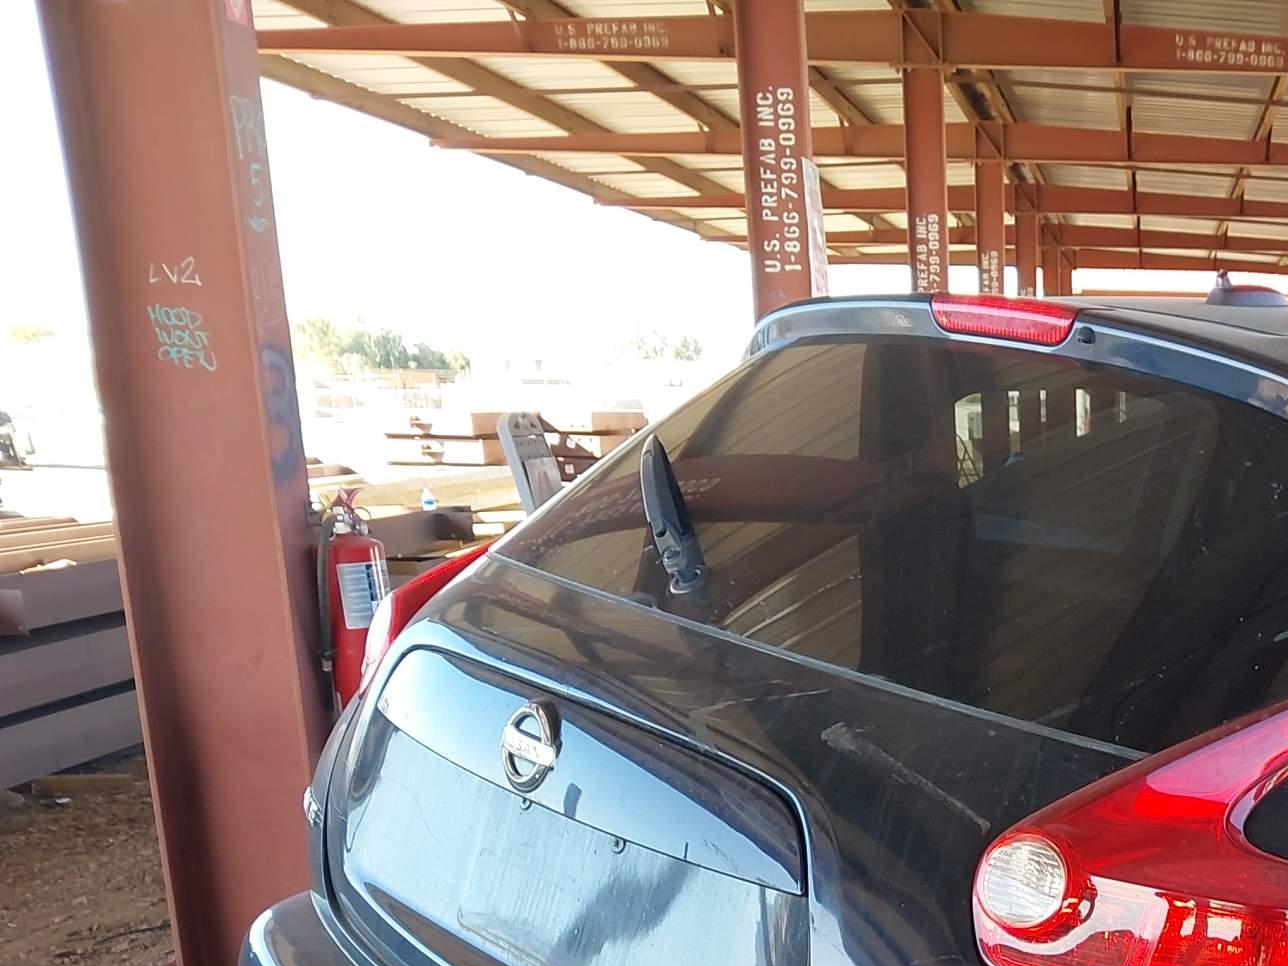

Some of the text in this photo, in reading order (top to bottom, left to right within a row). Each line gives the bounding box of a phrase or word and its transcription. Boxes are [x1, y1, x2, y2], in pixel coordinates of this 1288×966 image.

[756, 85, 781, 273] U.S. PREFAB INC.
[776, 87, 802, 271] 1-866-799-0969
[149, 256, 202, 286] LV2
[927, 213, 942, 293] -799-0969
